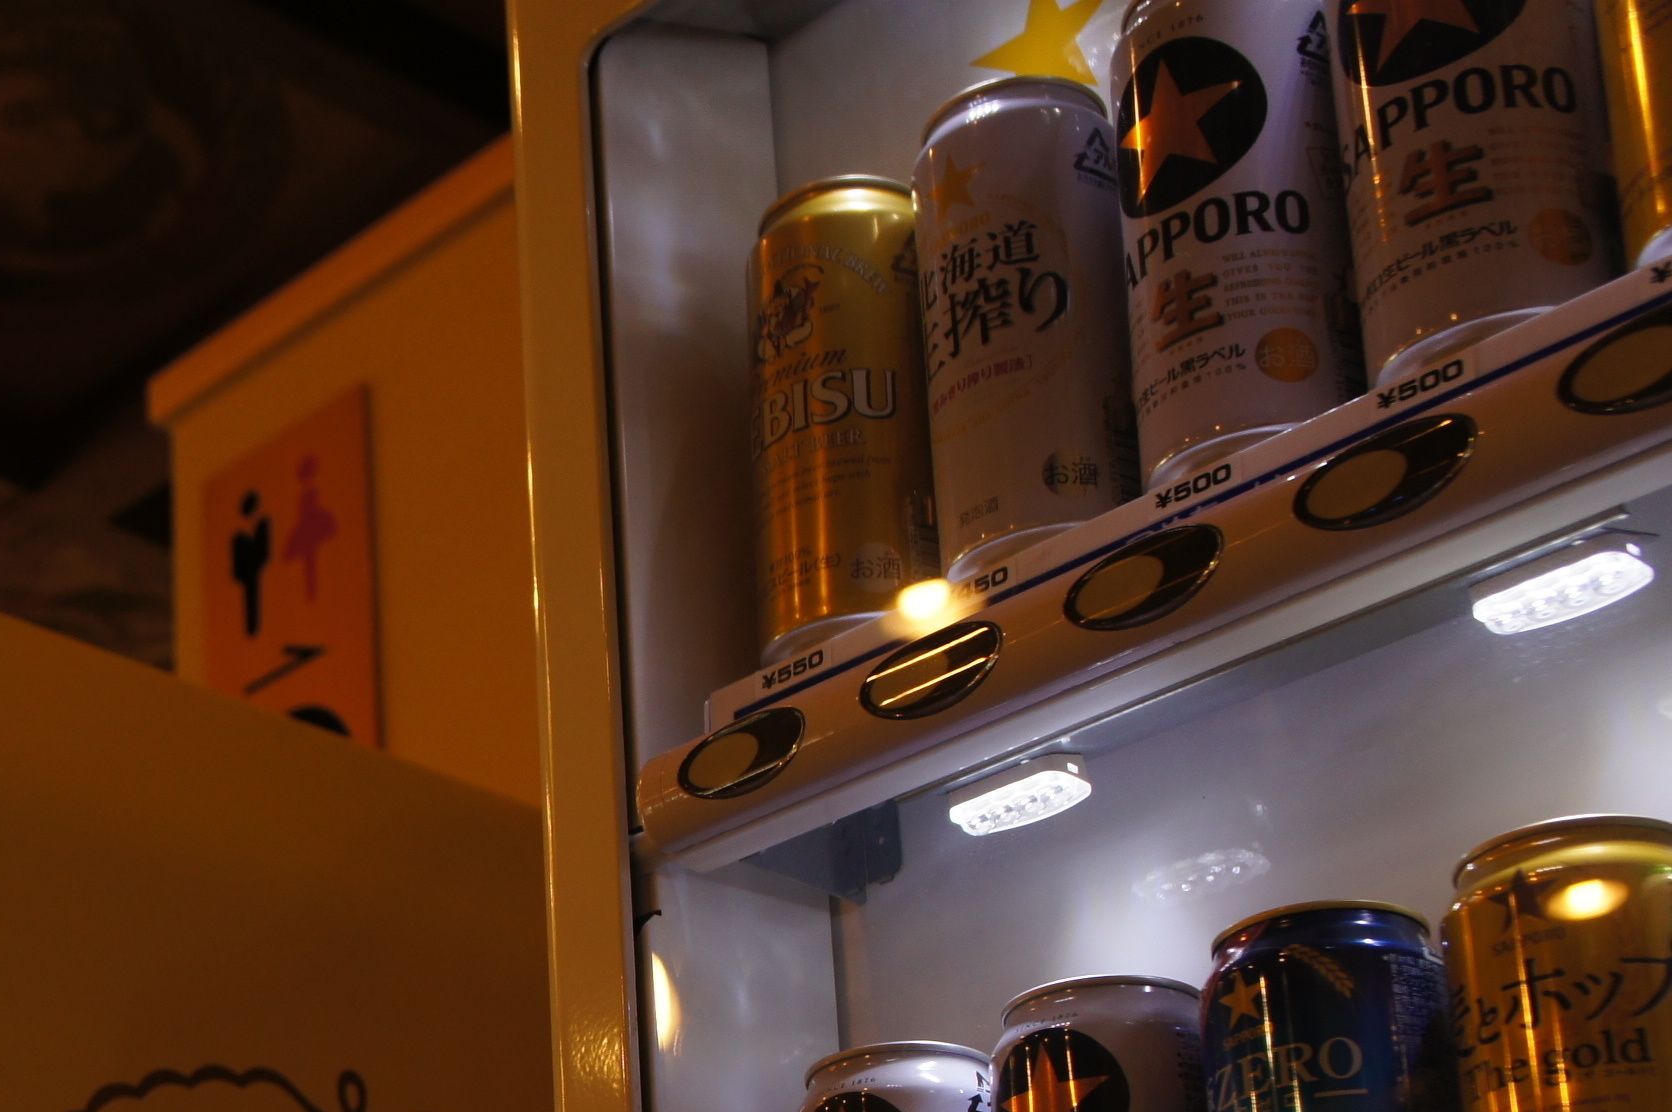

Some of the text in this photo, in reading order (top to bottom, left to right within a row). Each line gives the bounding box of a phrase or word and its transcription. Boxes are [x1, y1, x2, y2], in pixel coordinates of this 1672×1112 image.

[1399, 140, 1493, 226] 生
[1127, 190, 1310, 289] APPORO
[1151, 269, 1225, 352] 生
[1258, 339, 1314, 369] お酒
[1376, 360, 1464, 410] ¥500
[751, 368, 896, 464] EBISU
[1044, 461, 1099, 487] お酒
[1154, 463, 1232, 510] ¥500
[850, 555, 902, 581] お酒
[762, 650, 824, 690] ¥550
[1543, 1027, 1653, 1088] gold
